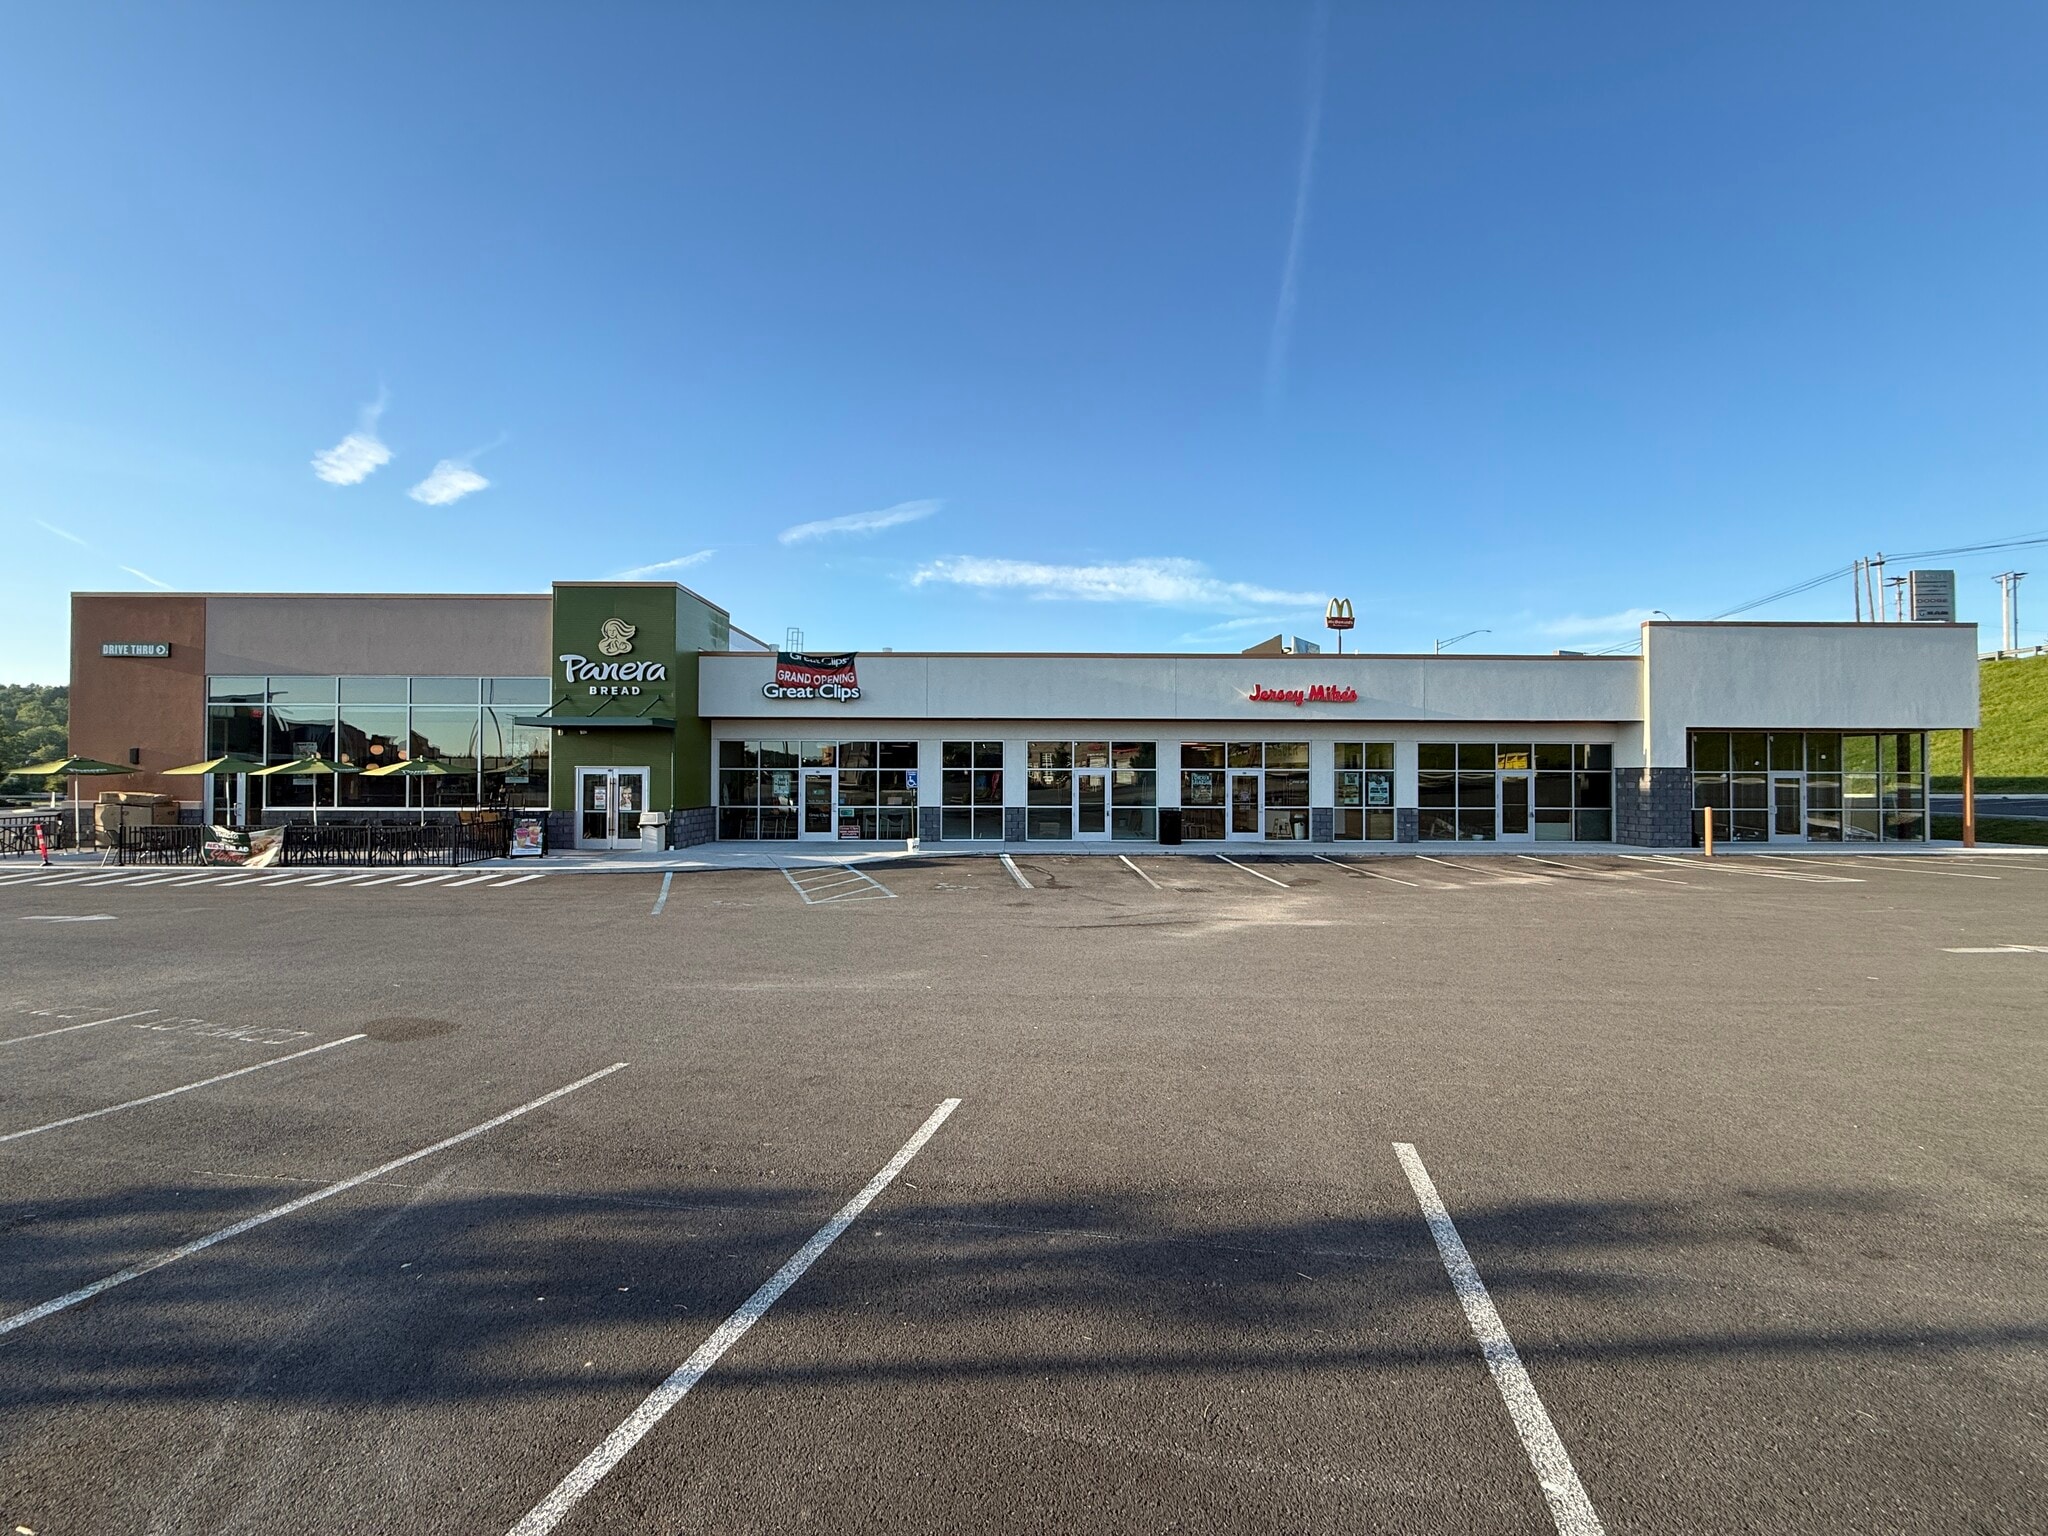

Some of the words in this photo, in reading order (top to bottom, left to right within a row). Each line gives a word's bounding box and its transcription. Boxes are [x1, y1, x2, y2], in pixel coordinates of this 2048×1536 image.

[102, 644, 129, 655] DRIVE
[131, 644, 155, 655] THRU
[559, 654, 666, 683] Panera
[777, 669, 812, 684] GRAND
[813, 671, 855, 685] OPENING
[589, 686, 641, 695] BREAD
[762, 682, 814, 699] Great
[819, 682, 861, 703] Clips
[1248, 684, 1304, 706] Jersey
[1308, 684, 1358, 702] Mike's
